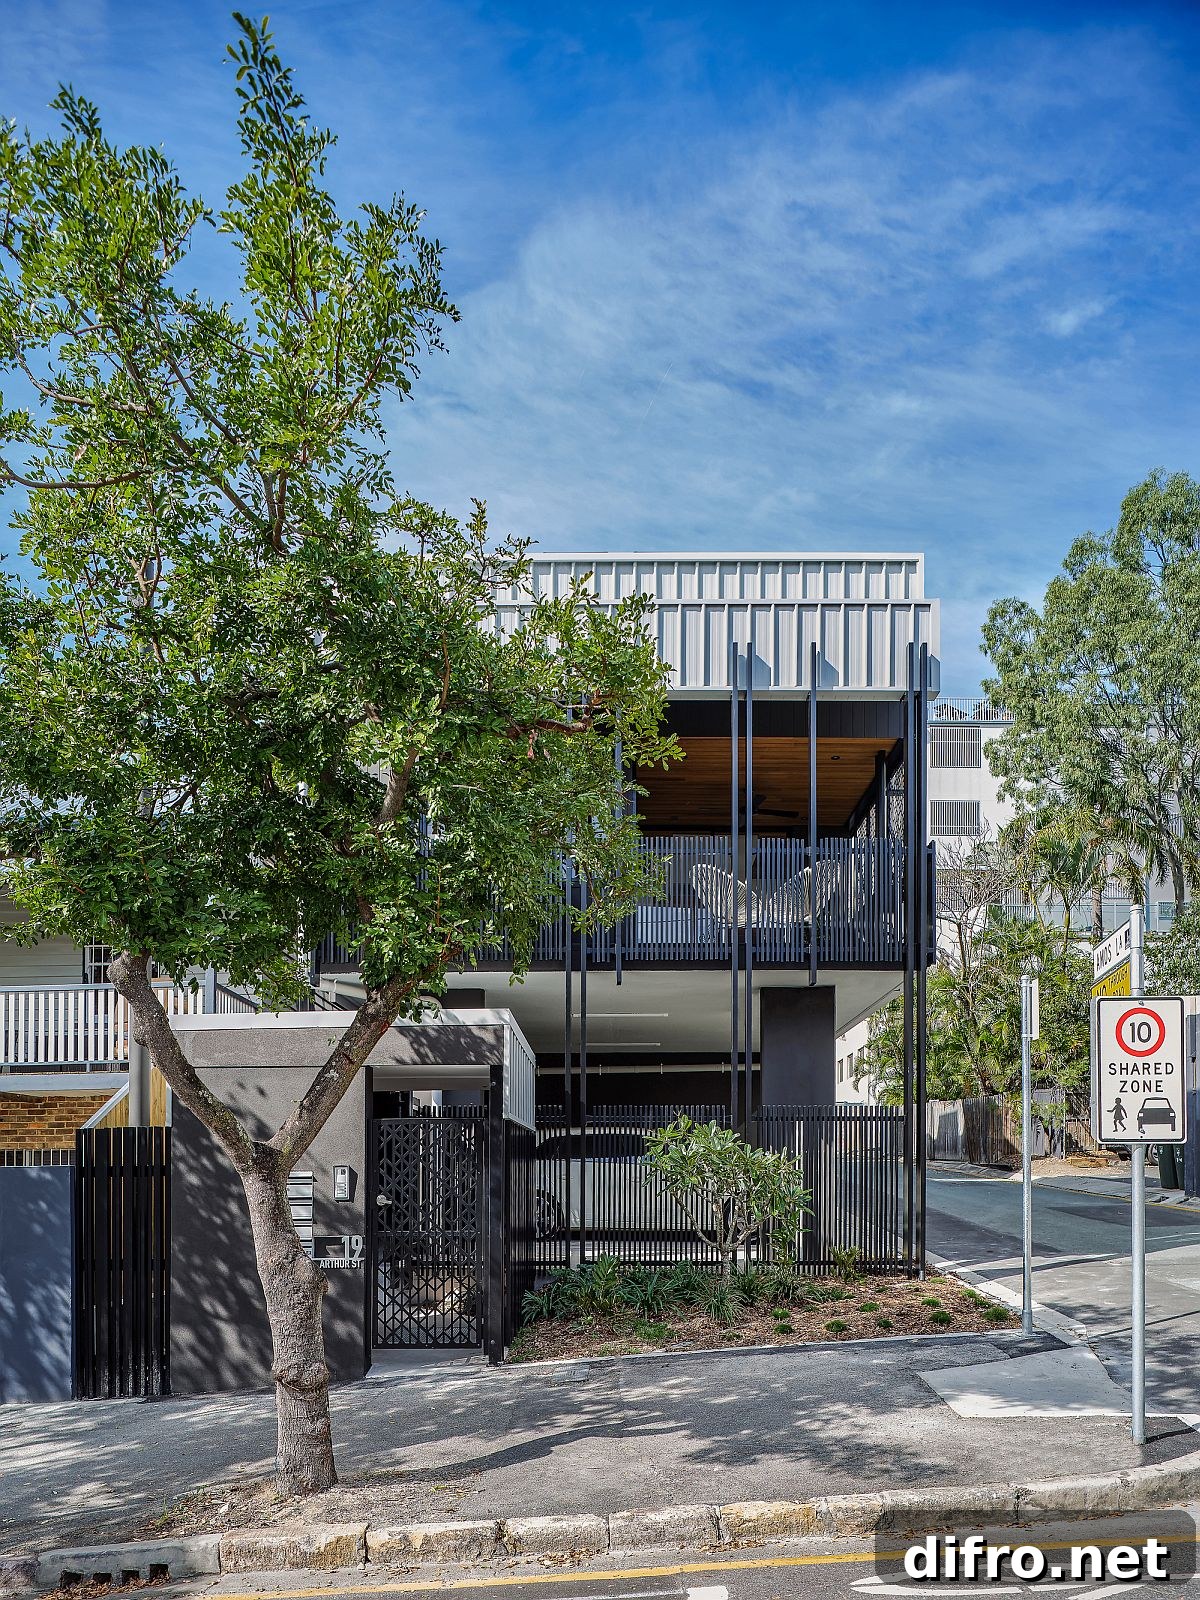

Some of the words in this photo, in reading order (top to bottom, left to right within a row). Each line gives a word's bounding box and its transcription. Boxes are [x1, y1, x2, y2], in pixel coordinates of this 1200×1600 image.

[1096, 943, 1112, 971] AMOS
[1108, 966, 1128, 989] THROUGH
[1130, 1022, 1151, 1043] 10
[1109, 1063, 1174, 1075] SHARED
[1119, 1080, 1164, 1093] ZONE
[341, 1235, 363, 1260] 19
[320, 1260, 350, 1269] ARTHUR
[351, 1260, 361, 1268] ST
